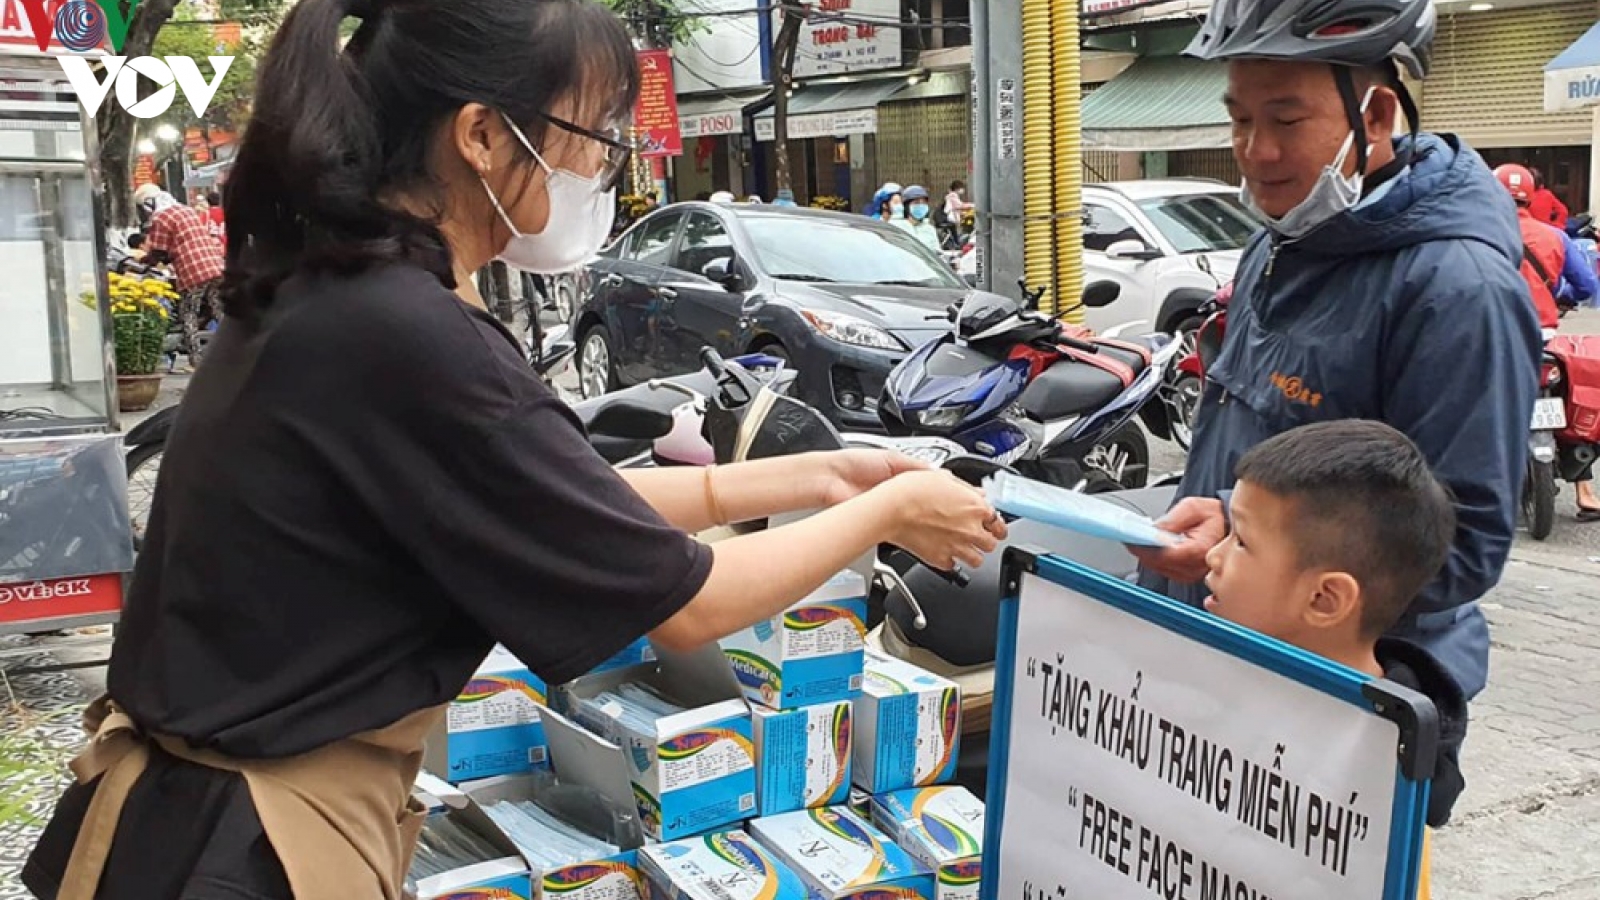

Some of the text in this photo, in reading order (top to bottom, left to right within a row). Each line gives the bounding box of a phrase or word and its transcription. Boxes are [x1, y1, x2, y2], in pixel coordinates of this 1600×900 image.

[700, 114, 734, 133] POSO
[1094, 670, 1153, 770] KHẨU
[1157, 718, 1233, 814] TRANG
[1237, 742, 1300, 849] MIỄN
[1136, 825, 1193, 900] FACE
